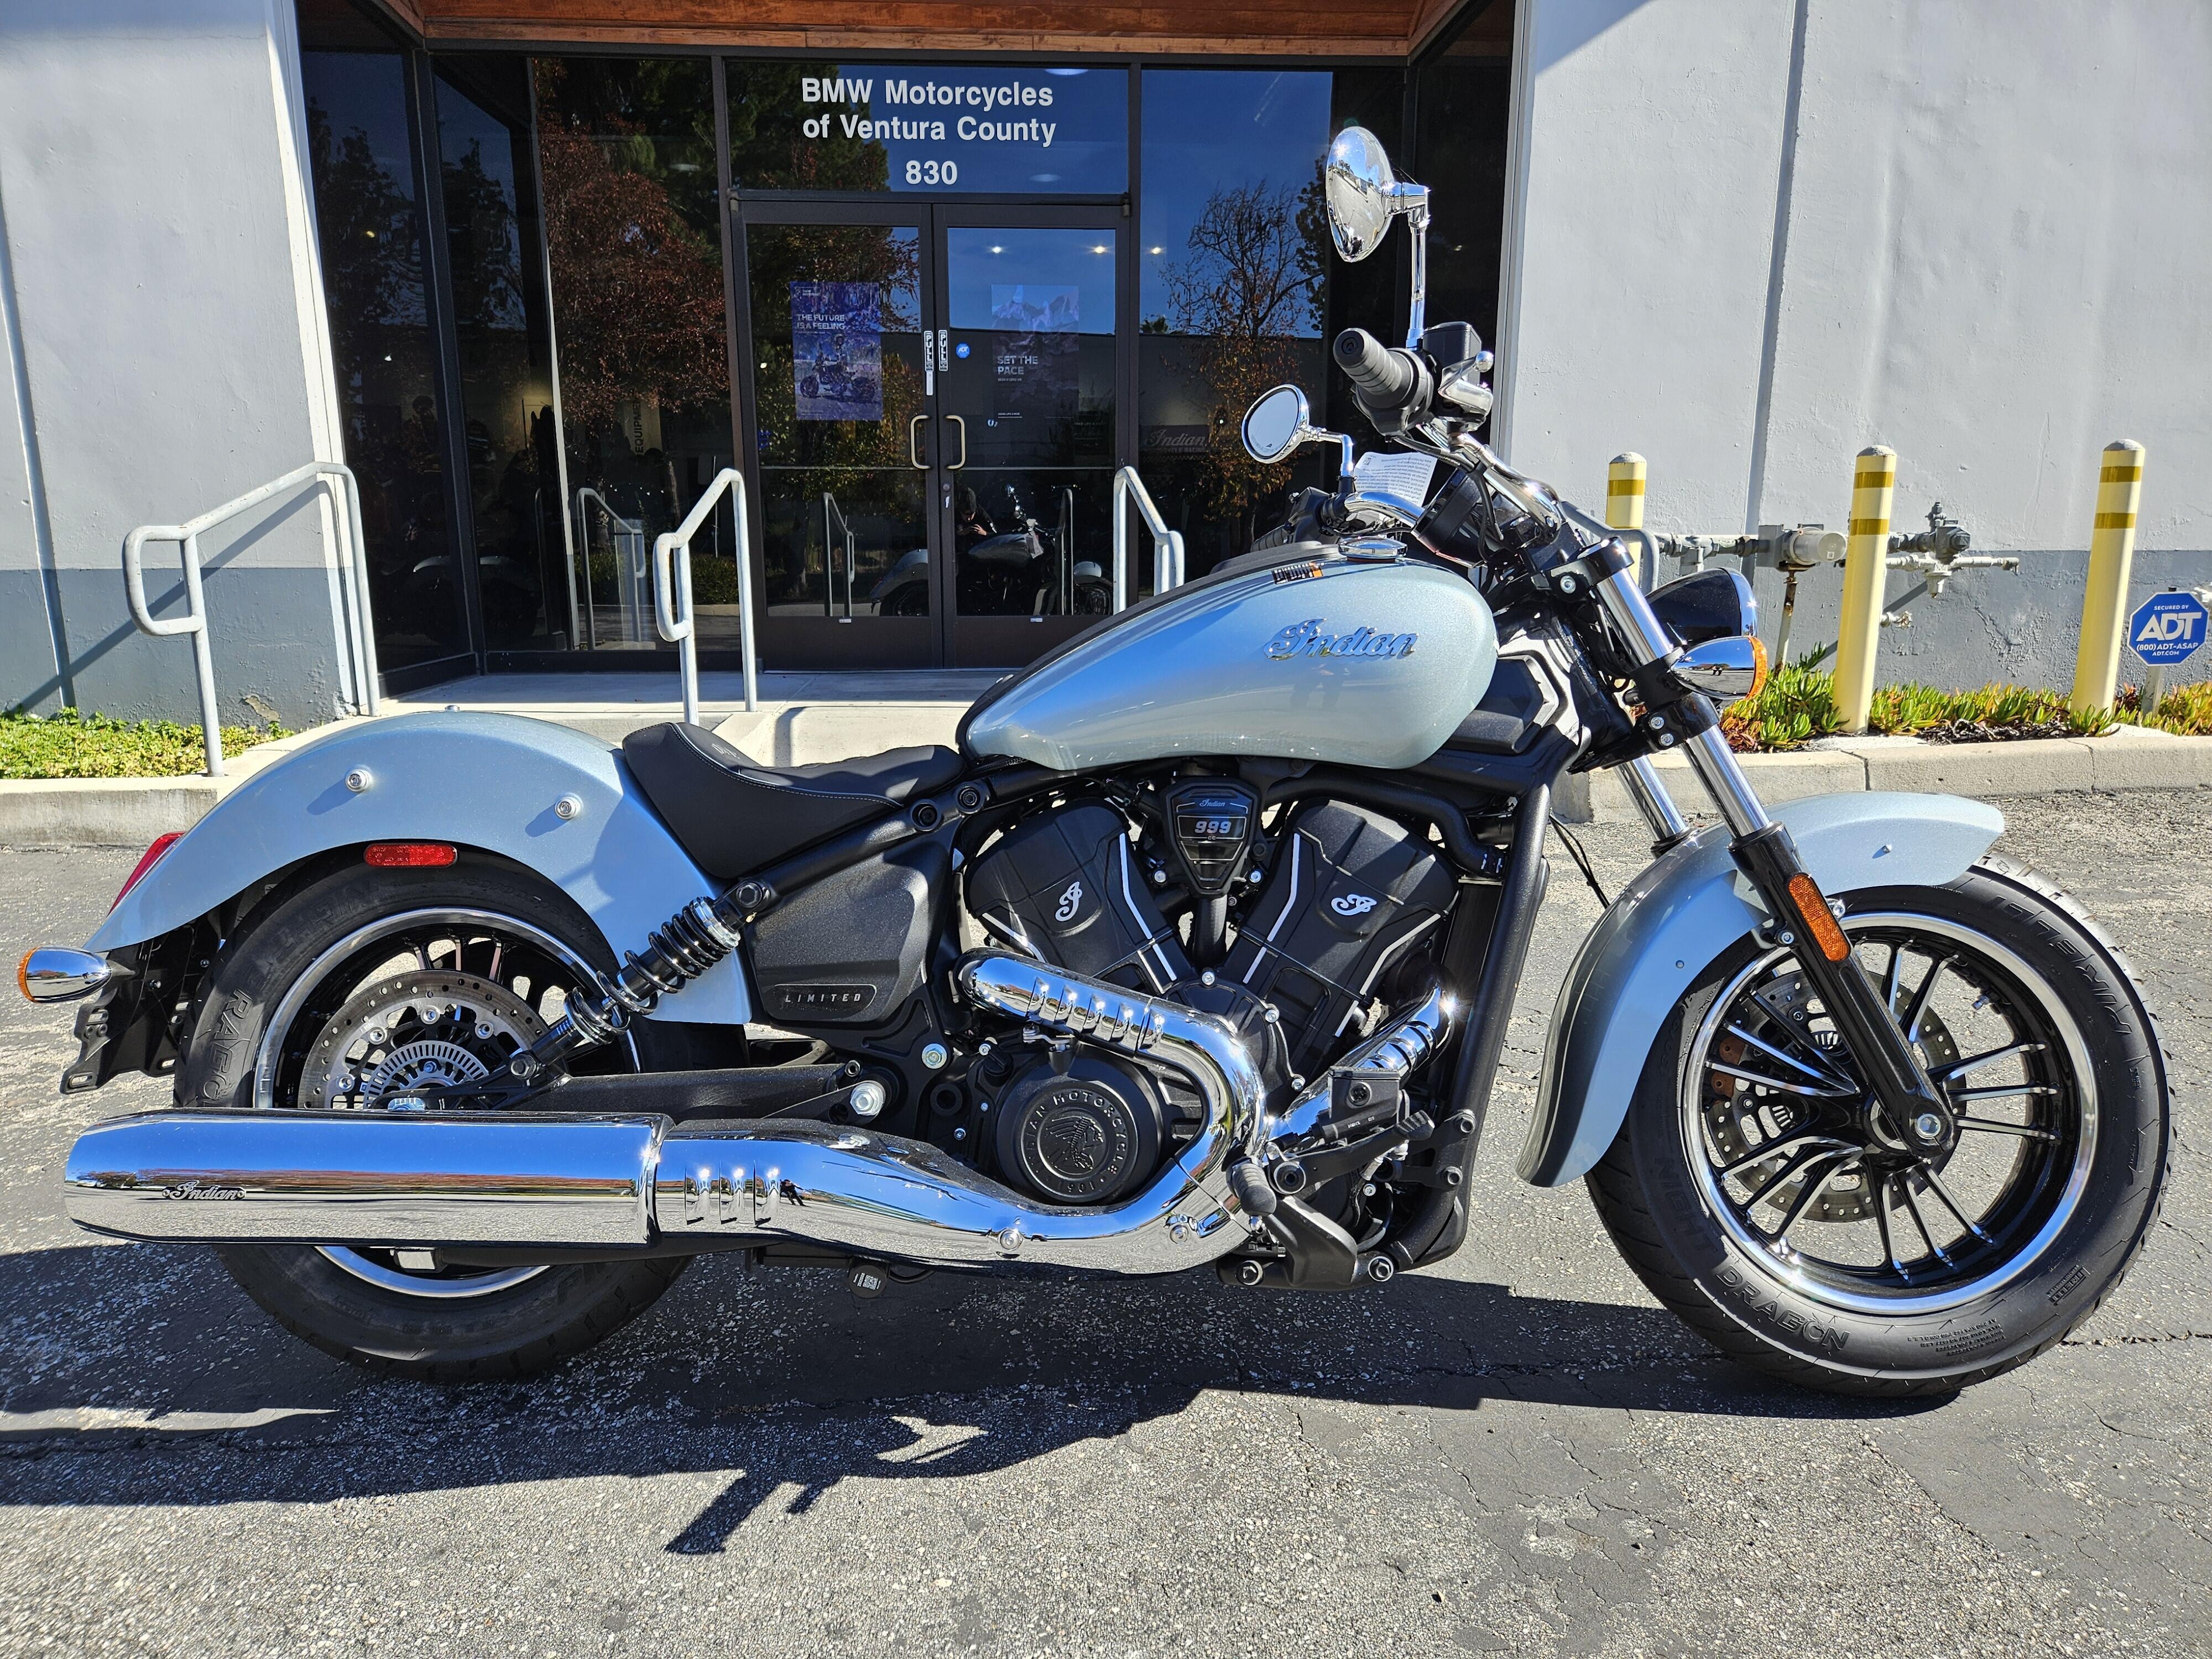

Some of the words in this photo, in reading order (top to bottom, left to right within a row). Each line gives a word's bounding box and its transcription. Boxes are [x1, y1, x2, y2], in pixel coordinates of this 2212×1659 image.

[802, 77, 873, 103] BMW
[885, 79, 1054, 112] Motorcycles
[802, 114, 831, 139] of
[840, 115, 946, 140] Ventura
[957, 116, 1056, 148] County
[905, 160, 958, 185] 830
[997, 356, 1017, 364] SET
[1018, 356, 1039, 365] THE
[997, 366, 1024, 375] PACE
[1143, 429, 1206, 447] Indian
[2136, 612, 2203, 642] ADT
[1263, 619, 1421, 661] Indian
[1199, 799, 1225, 807] Indian
[1194, 821, 1232, 833] 999
[785, 993, 861, 1003] LIMITED
[722, 1180, 791, 1201] Indian
[1716, 1264, 1851, 1351] DRAGON
